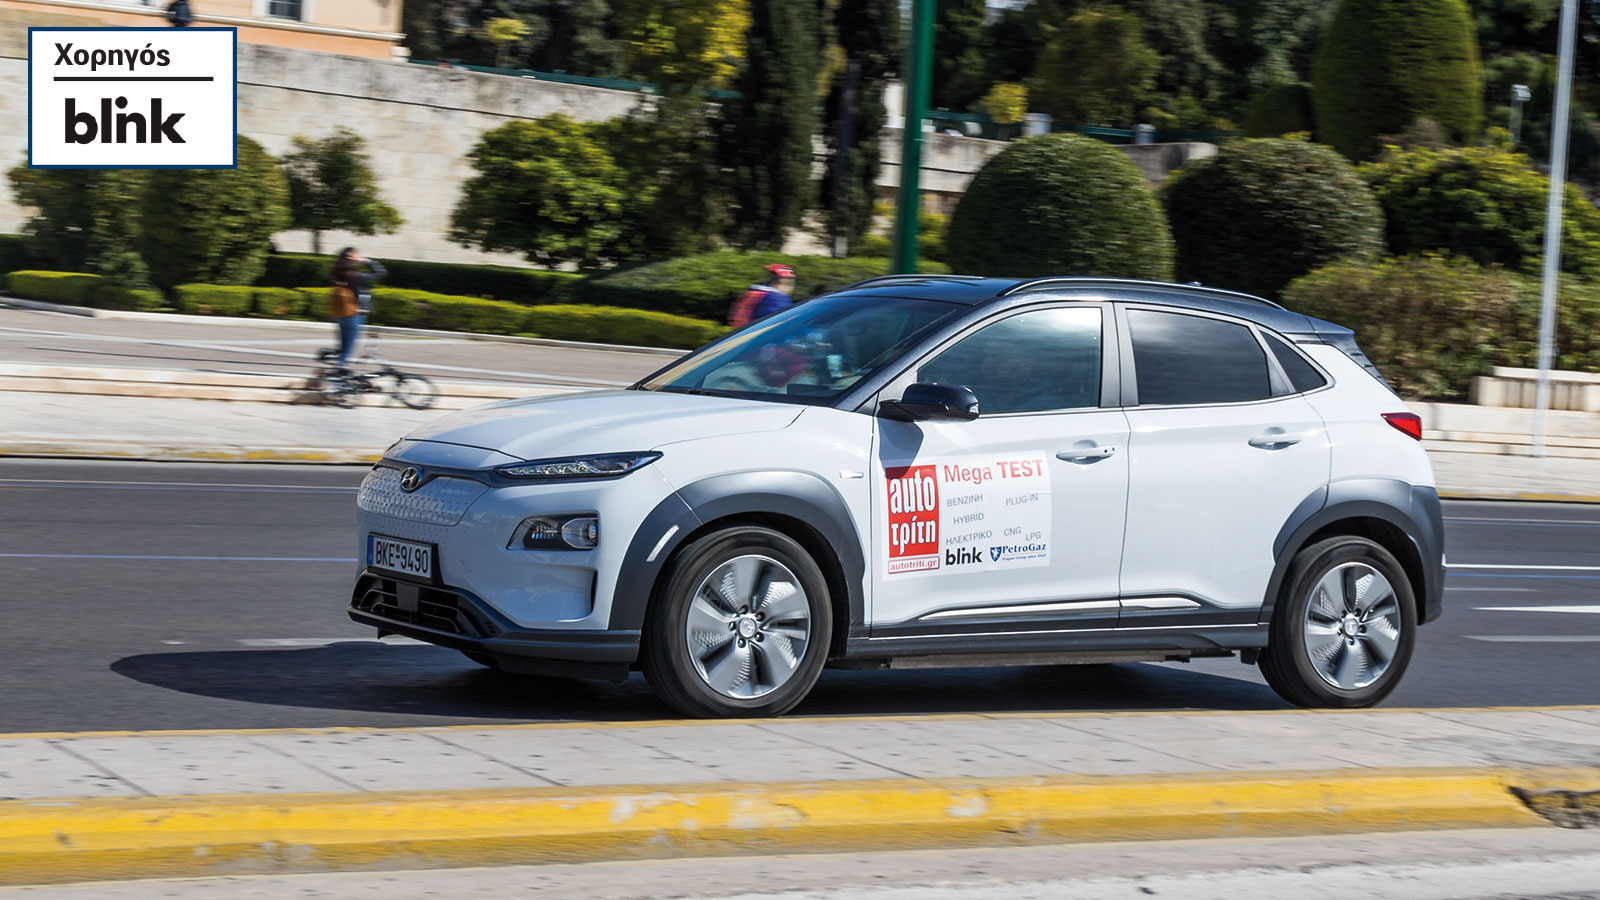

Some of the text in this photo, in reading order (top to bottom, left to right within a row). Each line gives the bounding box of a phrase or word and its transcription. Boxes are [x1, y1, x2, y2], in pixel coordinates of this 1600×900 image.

[944, 459, 1043, 485] Mega TEST
[889, 468, 936, 514] auto
[1005, 493, 1039, 506] PLUG-IN
[953, 512, 985, 525] HYBRID
[891, 515, 936, 555] τρίτη
[1003, 526, 1022, 536] CNG
[1025, 531, 1041, 541] LPG
[1002, 543, 1047, 554] PetroGaz
[945, 547, 983, 566] blink
[890, 560, 936, 571] autotriti.gr
